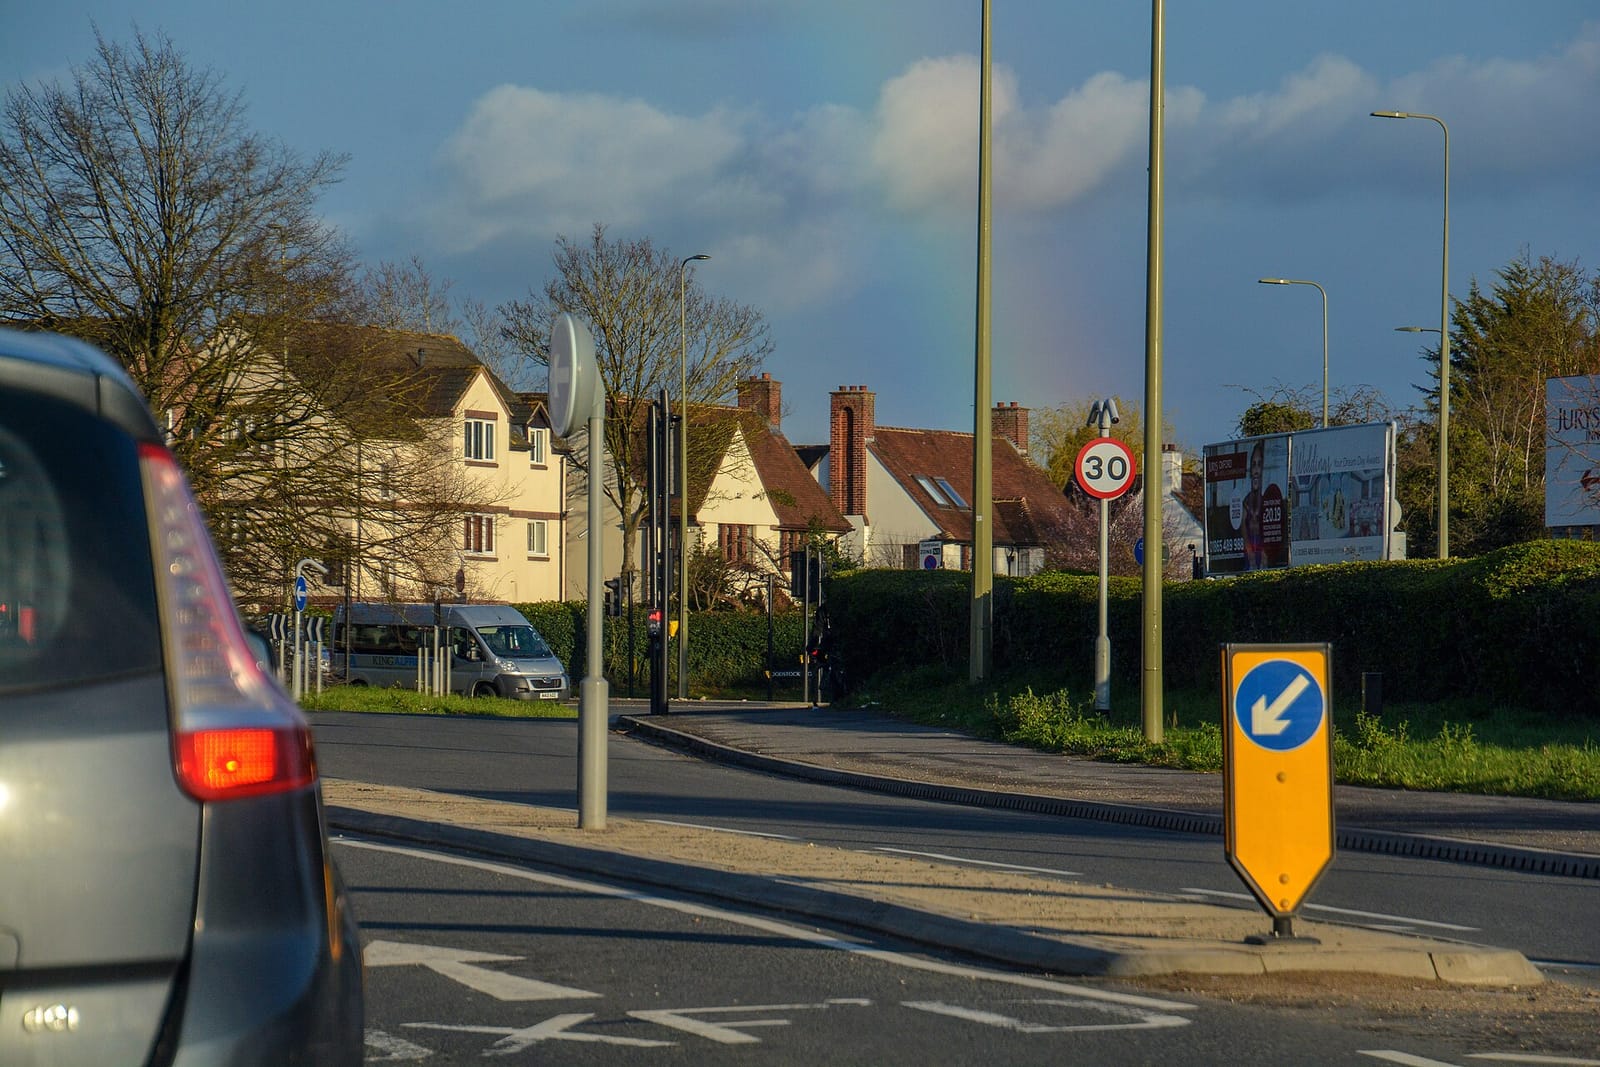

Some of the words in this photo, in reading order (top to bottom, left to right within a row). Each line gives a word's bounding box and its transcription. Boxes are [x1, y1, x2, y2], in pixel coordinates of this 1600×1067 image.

[1555, 406, 1600, 433] JURYS
[1085, 455, 1127, 481] 30
[372, 656, 394, 665] KING
